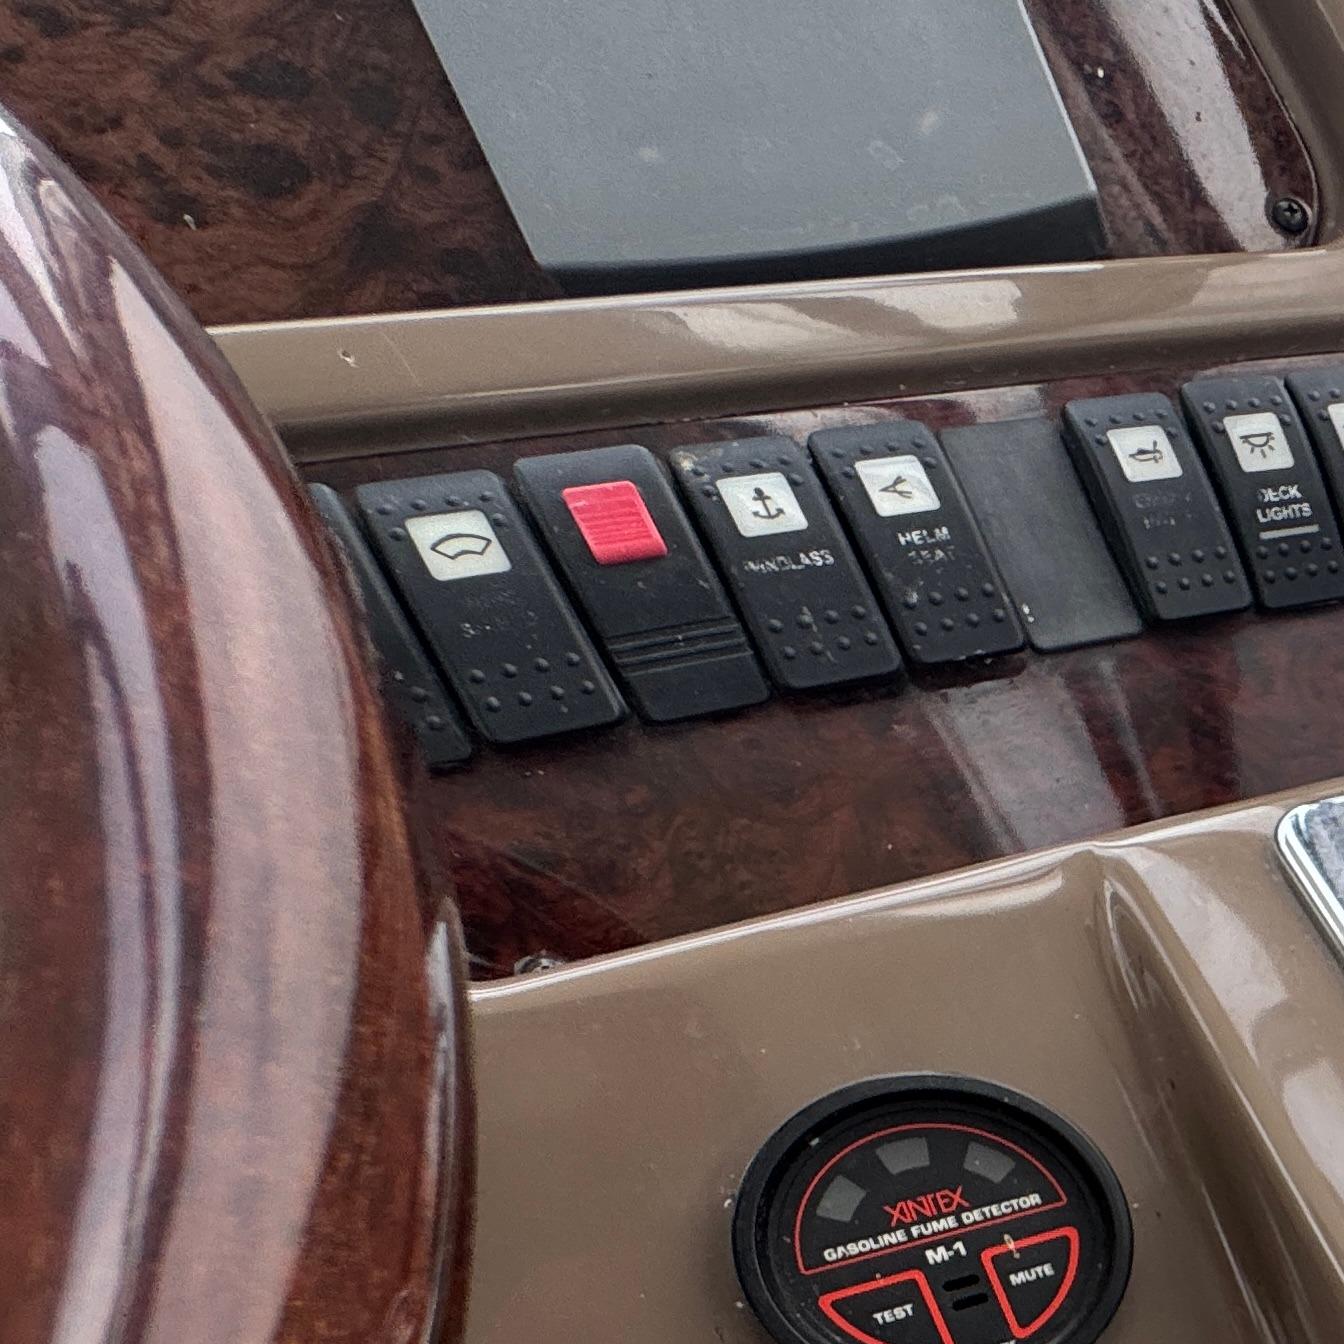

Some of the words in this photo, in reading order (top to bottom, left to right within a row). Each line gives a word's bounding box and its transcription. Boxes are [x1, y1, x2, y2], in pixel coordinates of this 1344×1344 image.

[1257, 502, 1314, 524] LIGHTS
[897, 525, 952, 546] HELM
[884, 1185, 971, 1227] XINTEX
[824, 1230, 908, 1262] GASOLINE
[911, 1214, 959, 1238] FUME
[961, 1193, 1043, 1225] DETECTOR
[925, 1241, 968, 1265] M-1
[1009, 1262, 1055, 1287] MUTE
[872, 1303, 914, 1325] TEST
